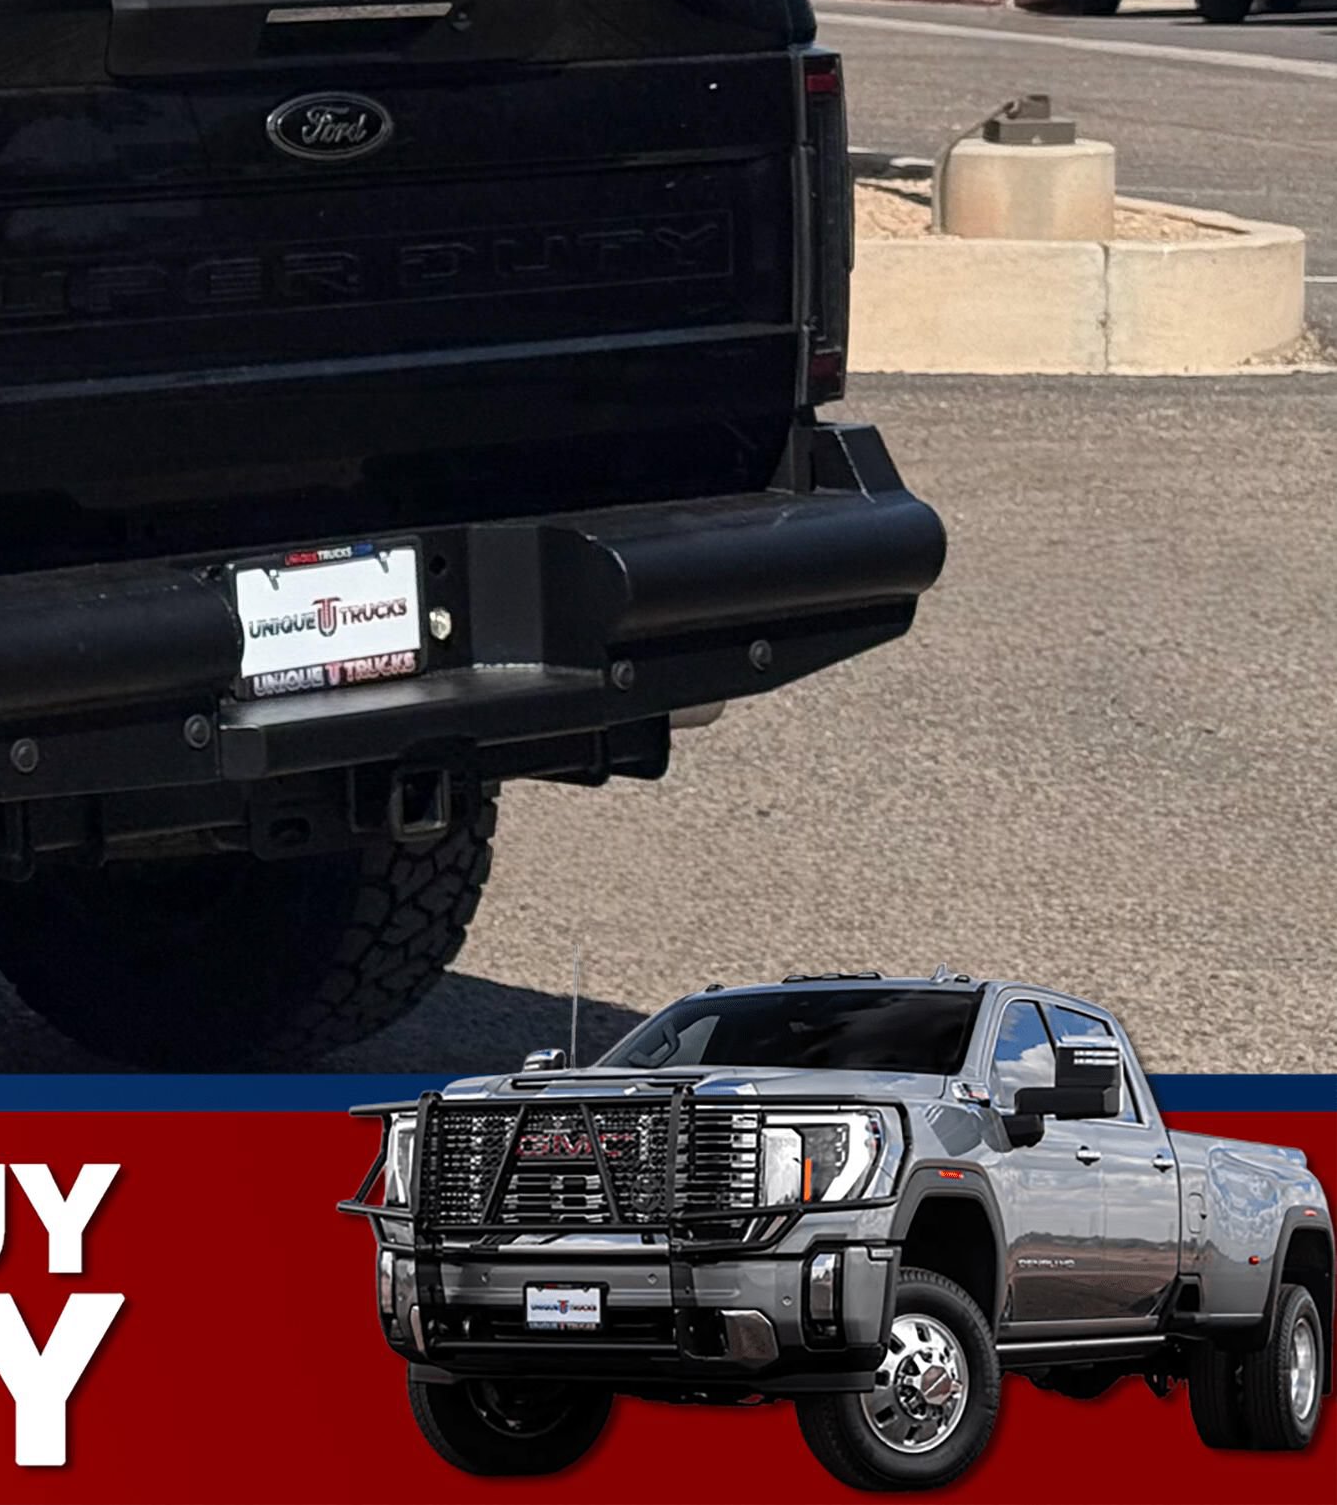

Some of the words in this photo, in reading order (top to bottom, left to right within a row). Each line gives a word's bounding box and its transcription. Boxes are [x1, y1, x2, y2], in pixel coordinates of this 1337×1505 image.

[301, 106, 368, 145] Ford
[398, 222, 718, 286] DUTY
[248, 611, 316, 639] UNIQUE
[339, 598, 407, 626] TRUCKS
[253, 666, 323, 697] UNIQUE
[344, 651, 416, 681] TRUCKS
